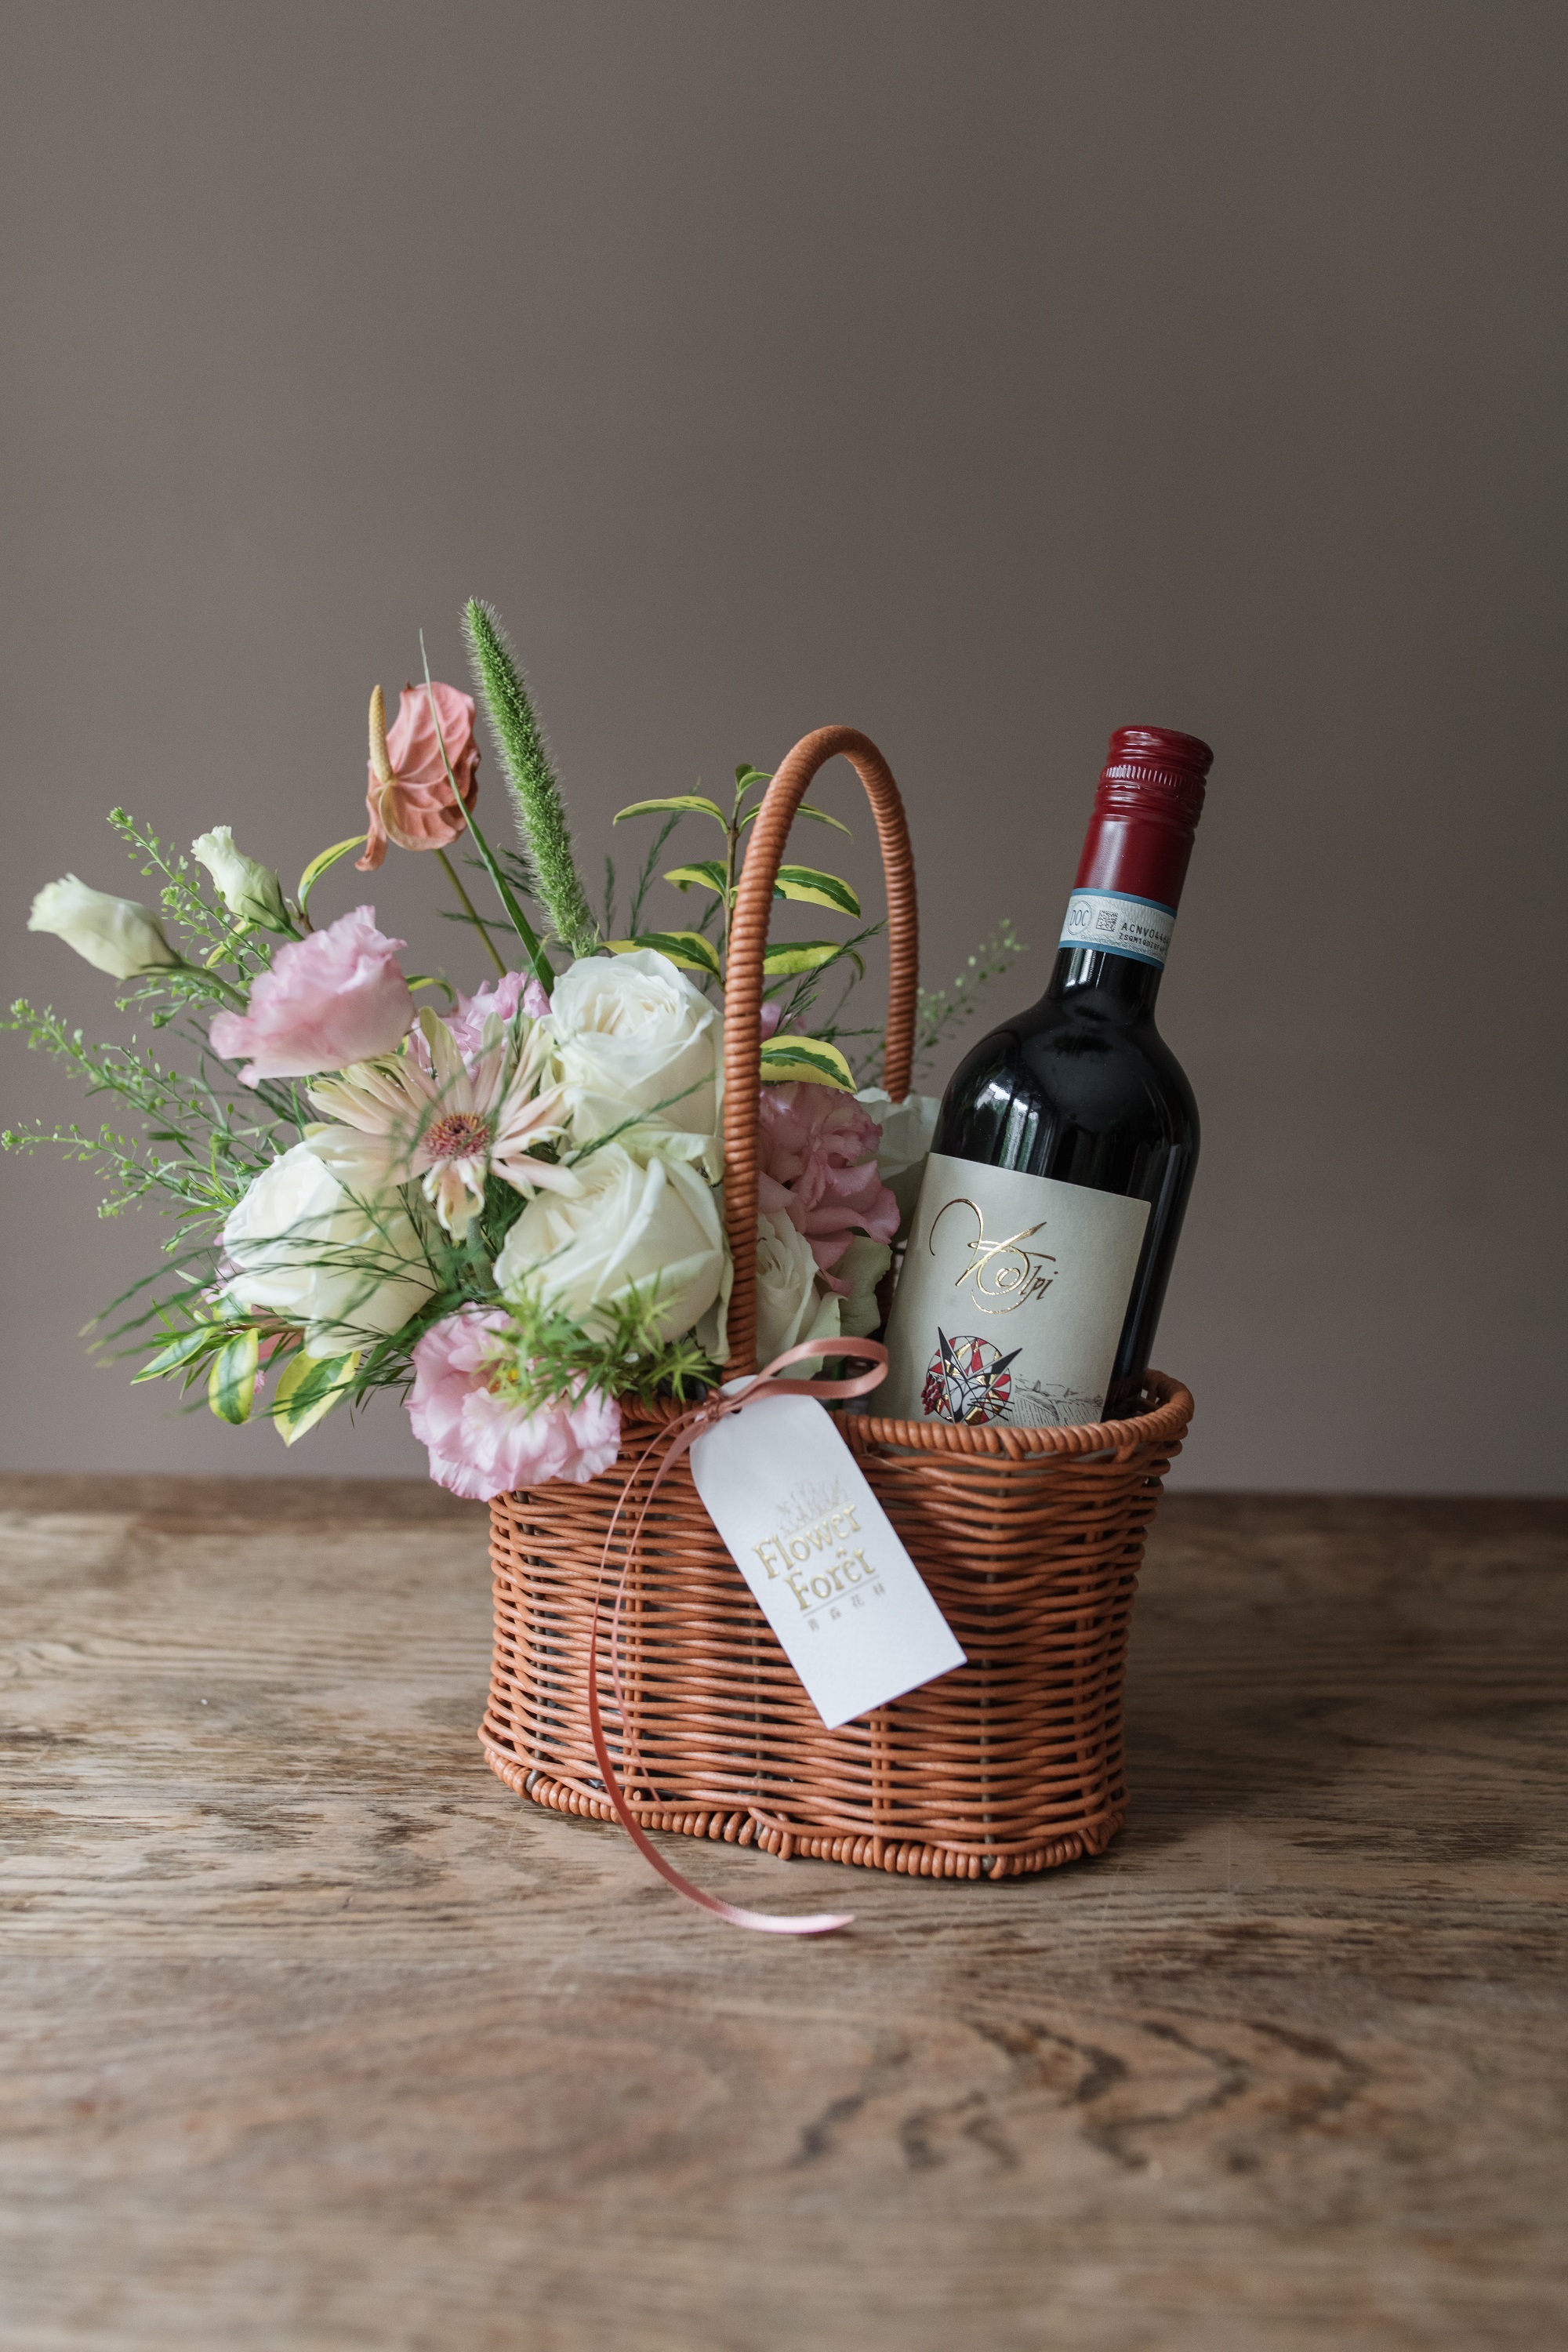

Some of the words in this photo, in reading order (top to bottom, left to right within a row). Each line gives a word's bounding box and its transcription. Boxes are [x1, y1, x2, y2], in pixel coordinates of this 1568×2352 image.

[1069, 909, 1090, 927] DOC
[752, 1504, 862, 1580] Flower
[783, 1546, 877, 1611] Forêt
